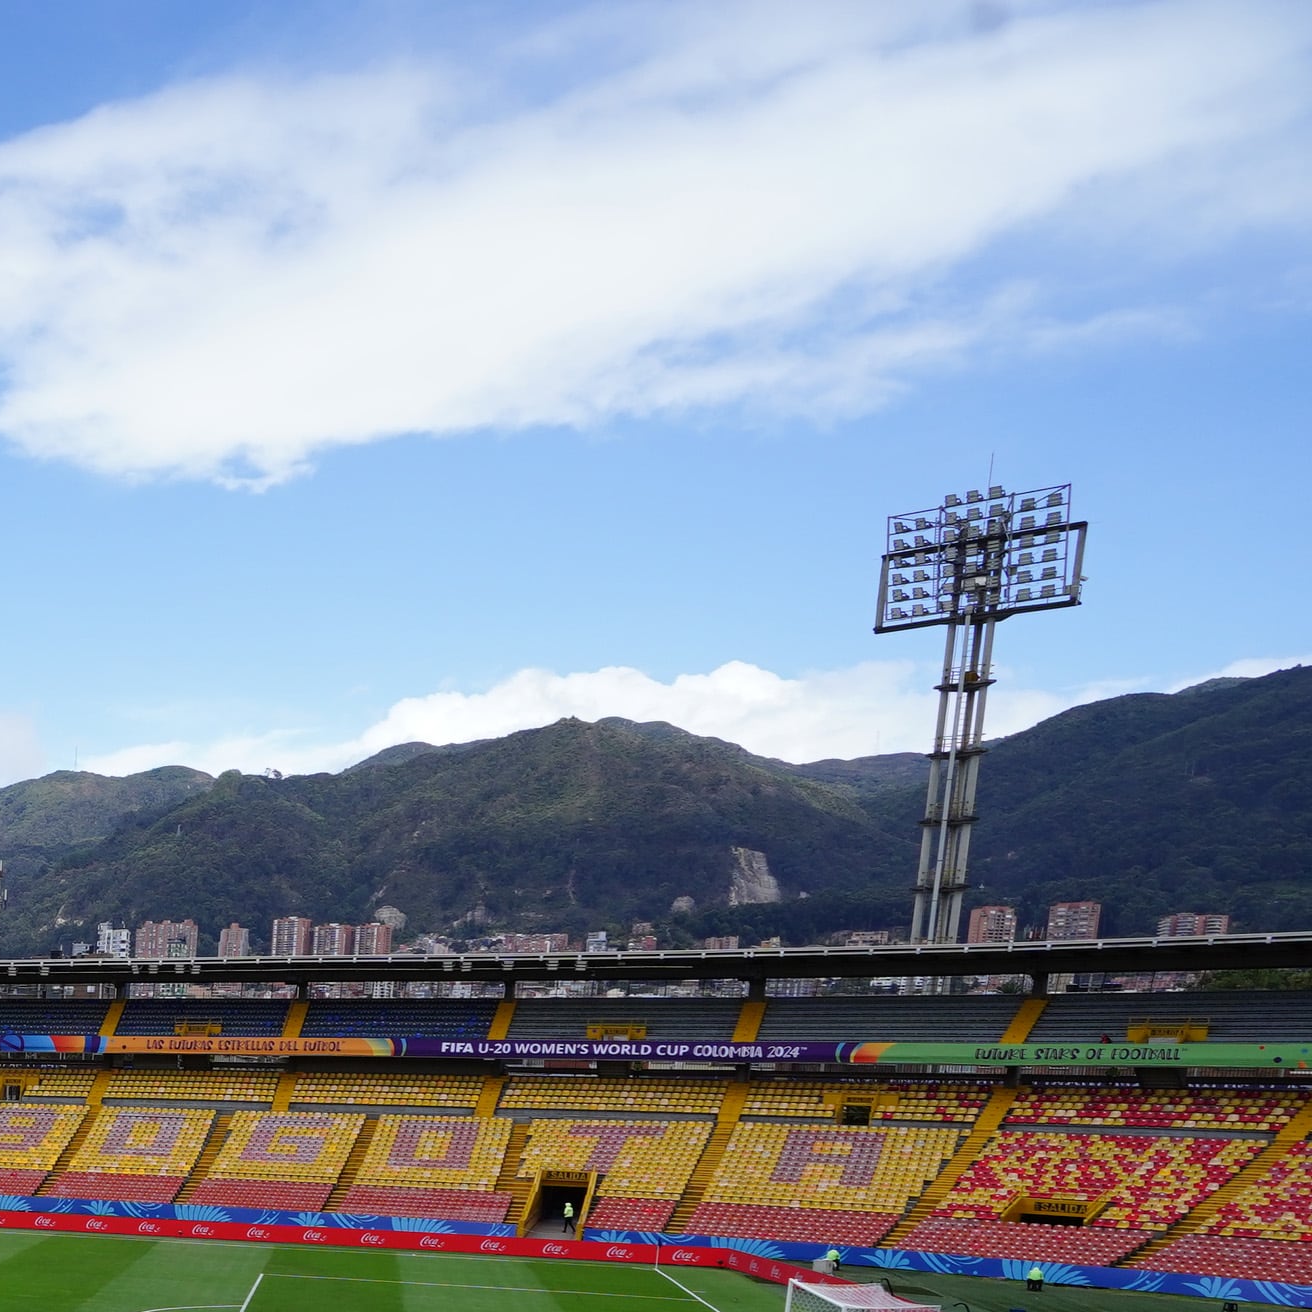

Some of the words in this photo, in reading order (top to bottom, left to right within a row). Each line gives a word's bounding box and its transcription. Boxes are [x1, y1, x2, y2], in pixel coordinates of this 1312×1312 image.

[146, 1039, 164, 1049] LAS
[218, 1040, 275, 1051] ESTRELLAS
[279, 1041, 299, 1051] DEL
[441, 1042, 474, 1053] FIFA
[478, 1043, 511, 1054] U-20
[515, 1043, 589, 1055] WOMEN'S
[593, 1044, 652, 1056] WORLD
[656, 1045, 689, 1056] CUP
[693, 1045, 762, 1058] COLOMBIA
[976, 1048, 1026, 1059] FUTURE
[1034, 1048, 1079, 1060] STARS
[1086, 1048, 1104, 1060] OF
[551, 1171, 587, 1180] SALIDA
[1041, 1203, 1087, 1213] SALIDA
